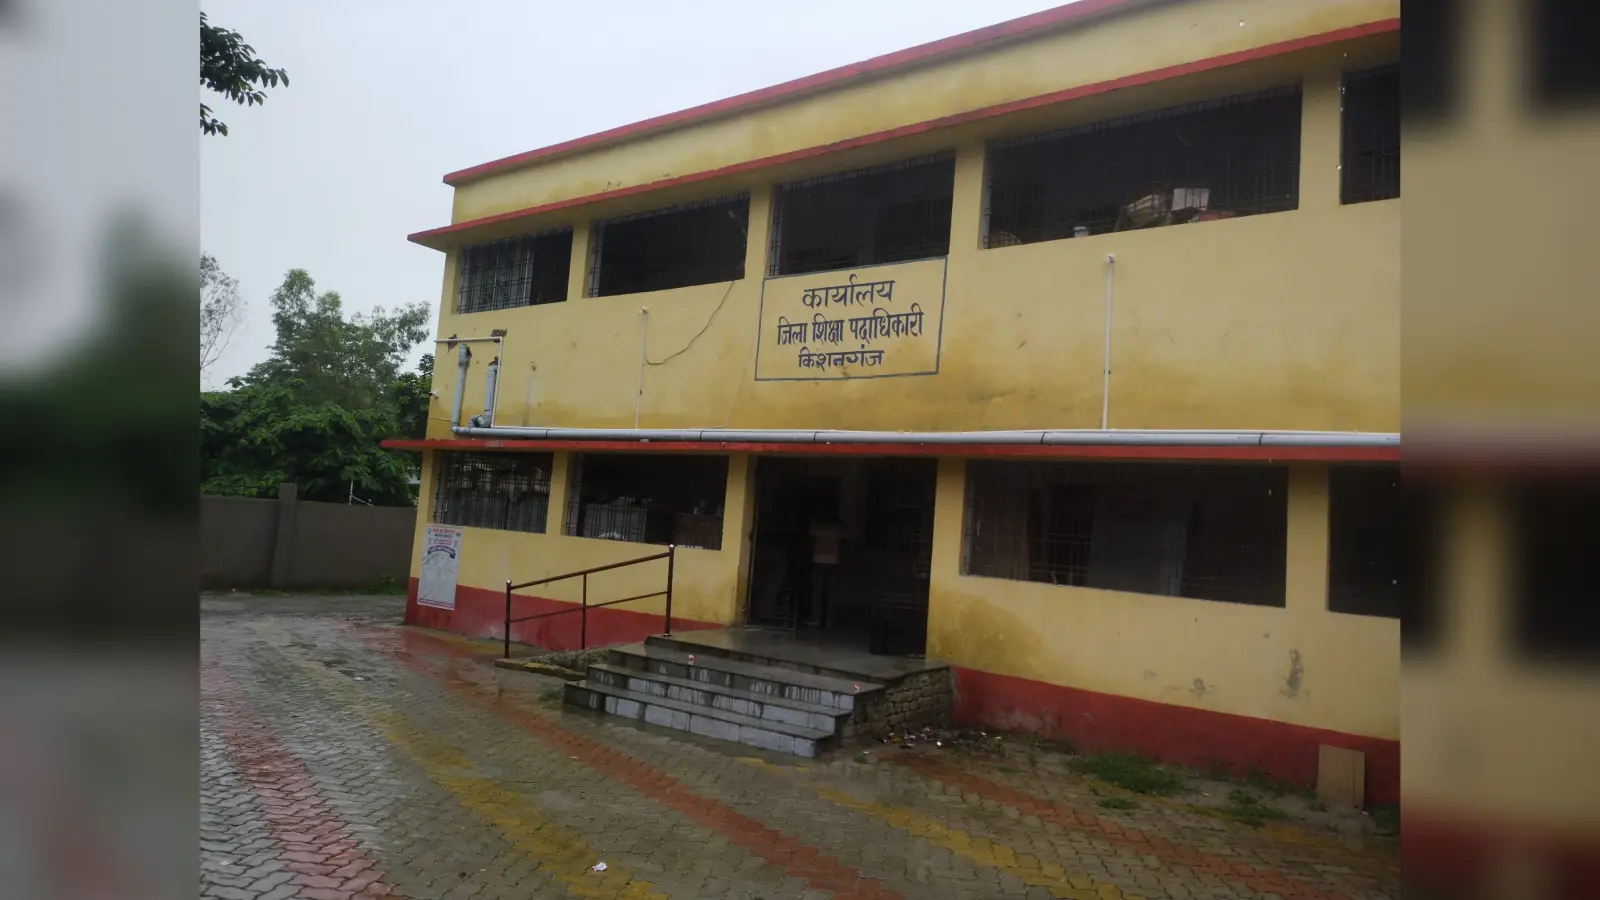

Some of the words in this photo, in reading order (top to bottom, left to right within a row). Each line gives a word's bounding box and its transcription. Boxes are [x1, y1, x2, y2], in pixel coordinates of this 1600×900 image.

[802, 274, 896, 309] कार्यालय
[777, 316, 808, 345] जिला
[812, 313, 844, 346] शिक्षा
[848, 302, 924, 344] पदाधिकारी
[798, 343, 885, 372] किशनगंज
